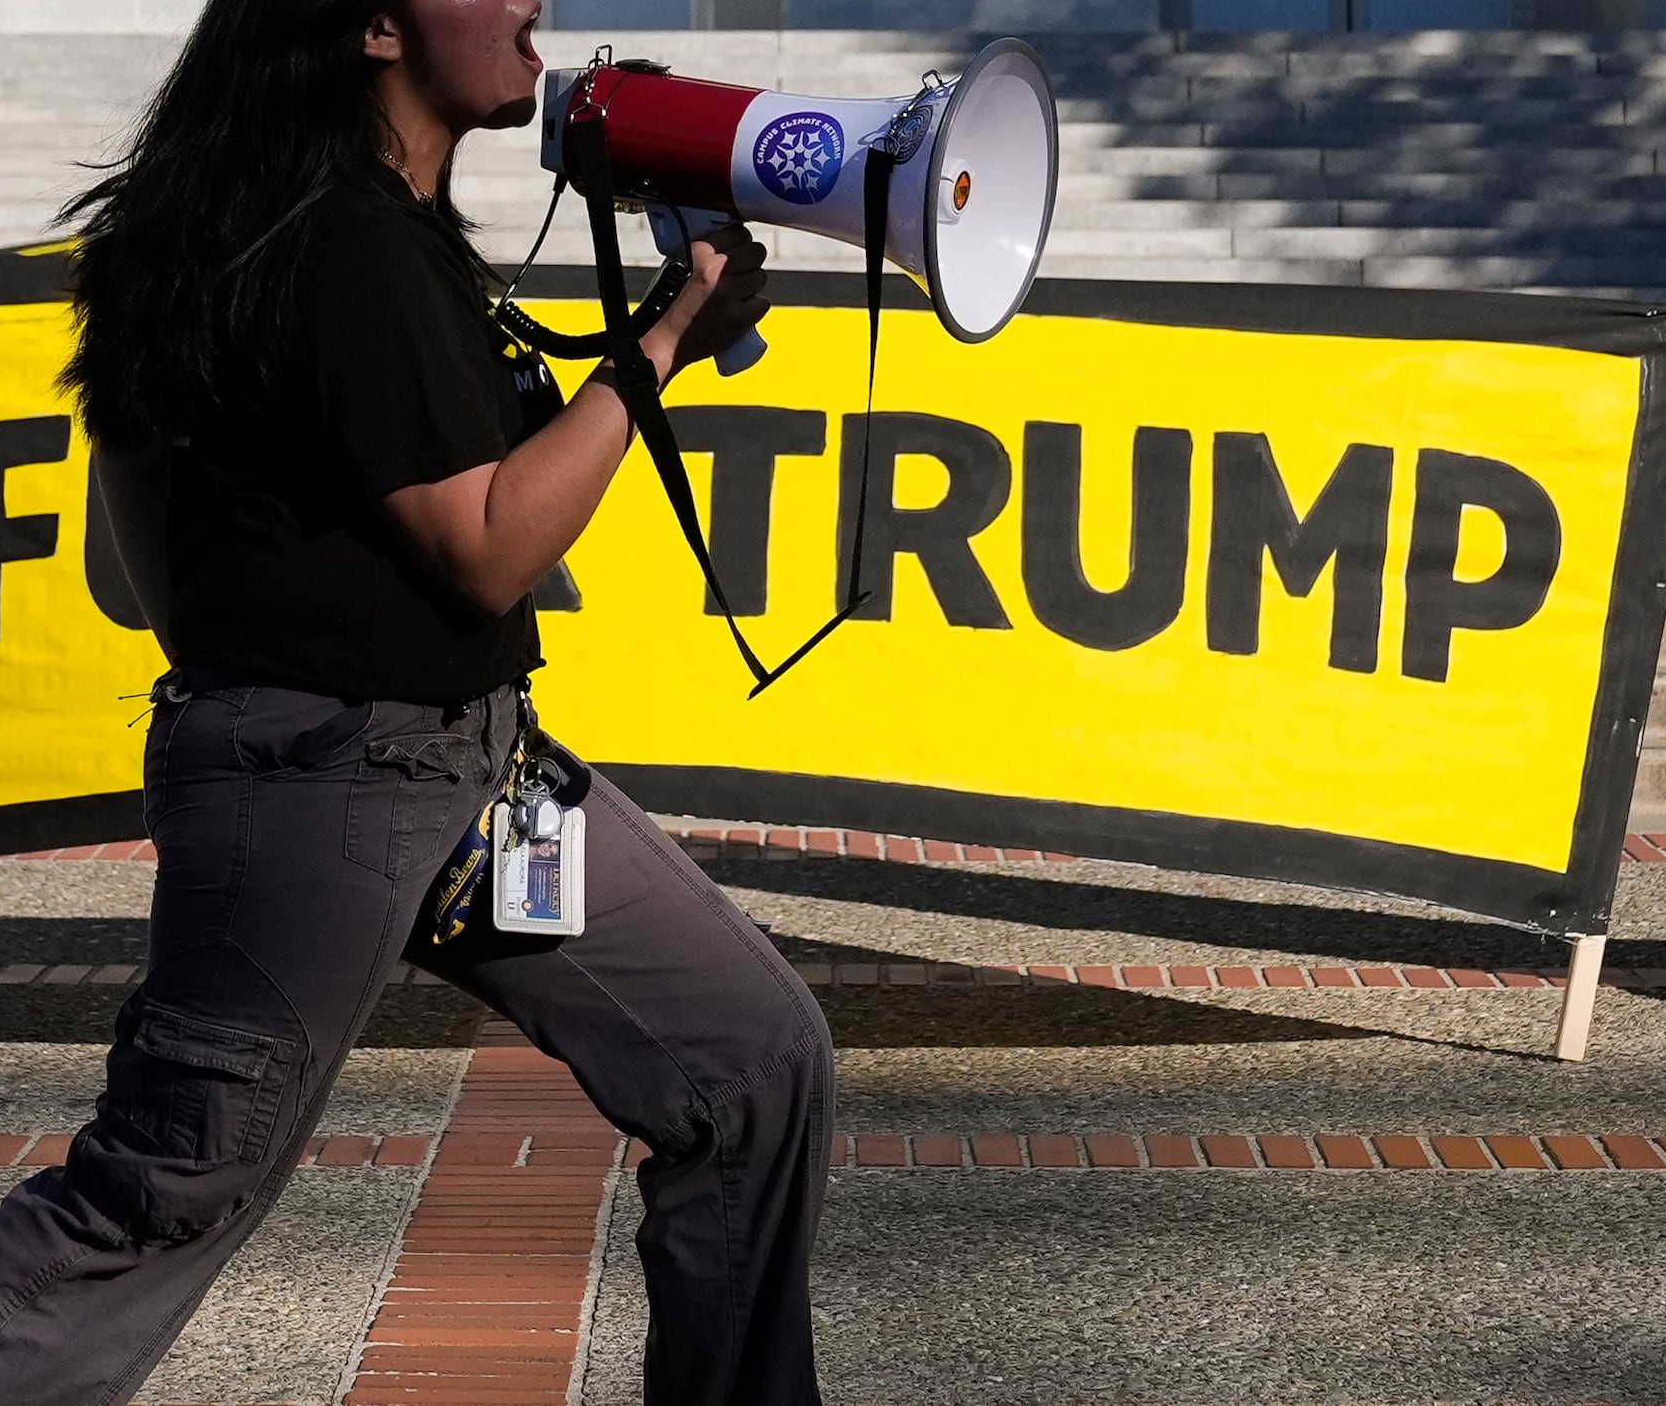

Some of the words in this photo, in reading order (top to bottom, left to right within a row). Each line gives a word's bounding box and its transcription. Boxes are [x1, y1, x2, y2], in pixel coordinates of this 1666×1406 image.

[757, 128, 779, 164] CAMPUS
[780, 117, 822, 130] CLIMATE
[821, 122, 841, 160] NETWORK
[665, 404, 1563, 684] TRUMP
